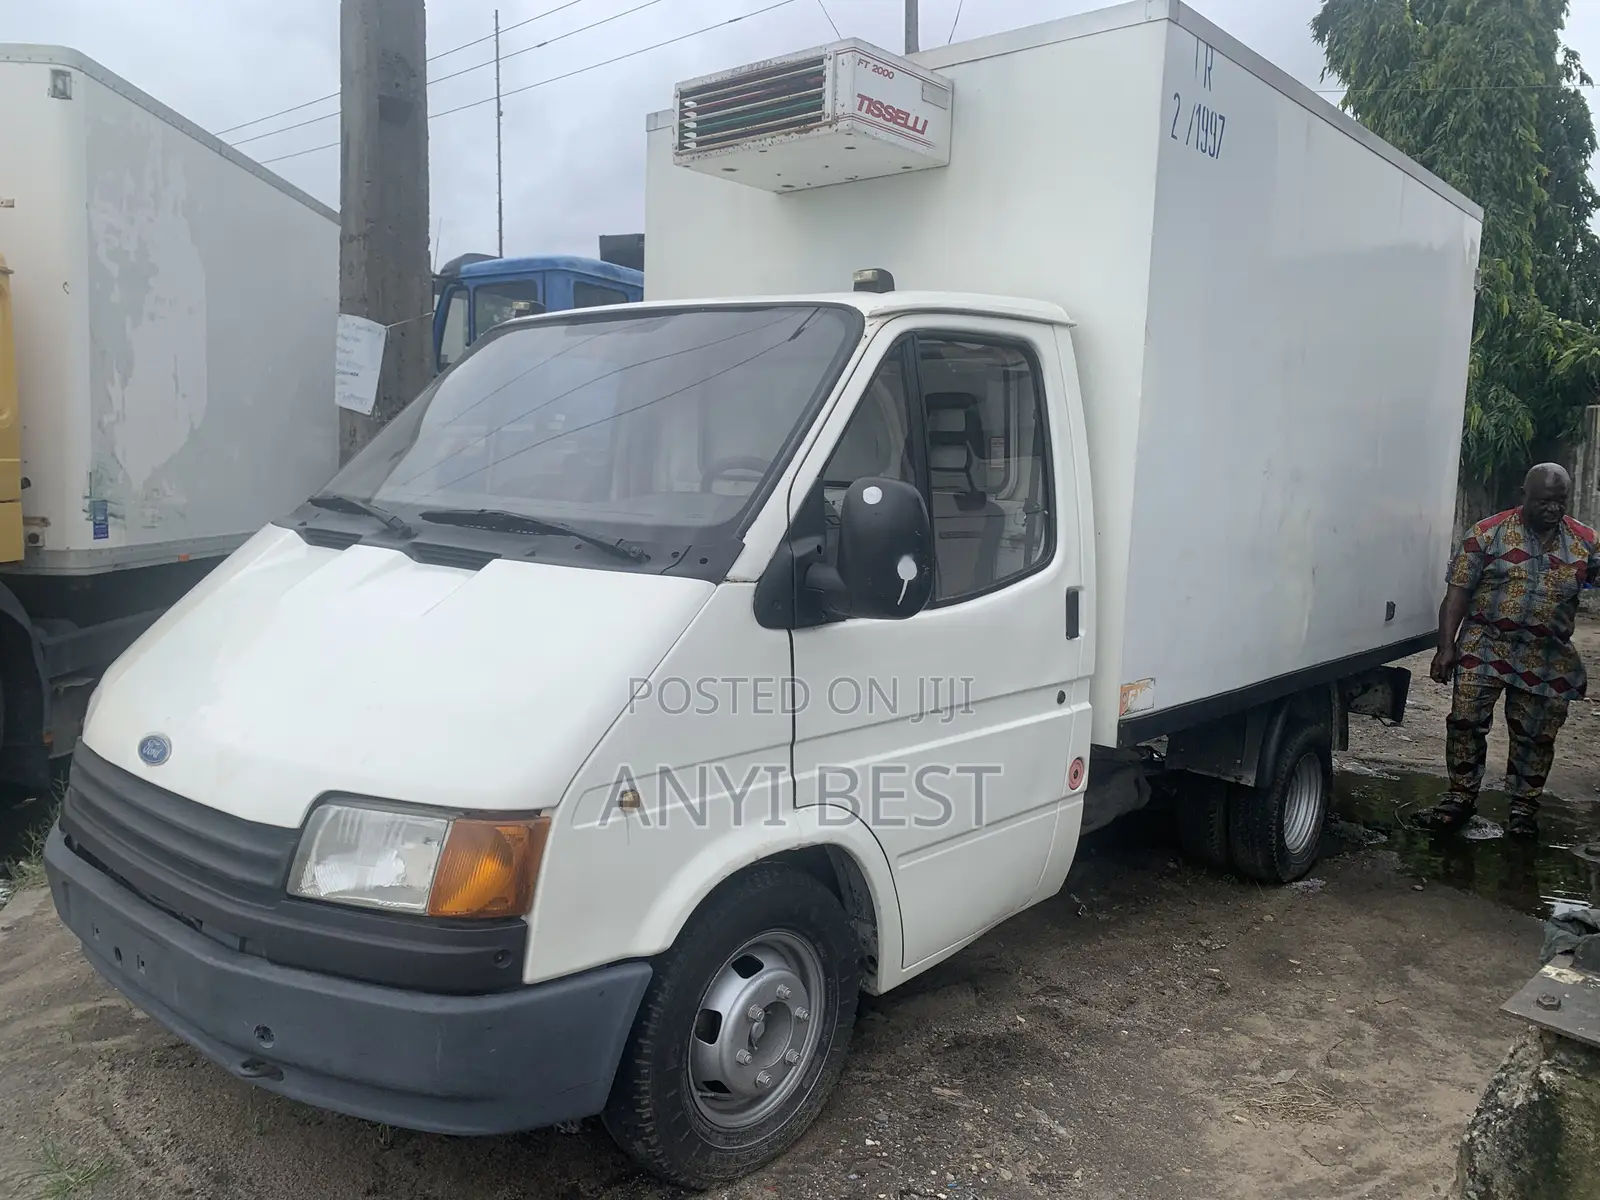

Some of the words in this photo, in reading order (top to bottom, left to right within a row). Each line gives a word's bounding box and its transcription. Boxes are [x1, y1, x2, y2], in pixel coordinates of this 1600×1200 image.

[857, 58, 871, 69] FT
[871, 64, 895, 80] 2000
[856, 92, 929, 136] TISSELLI
